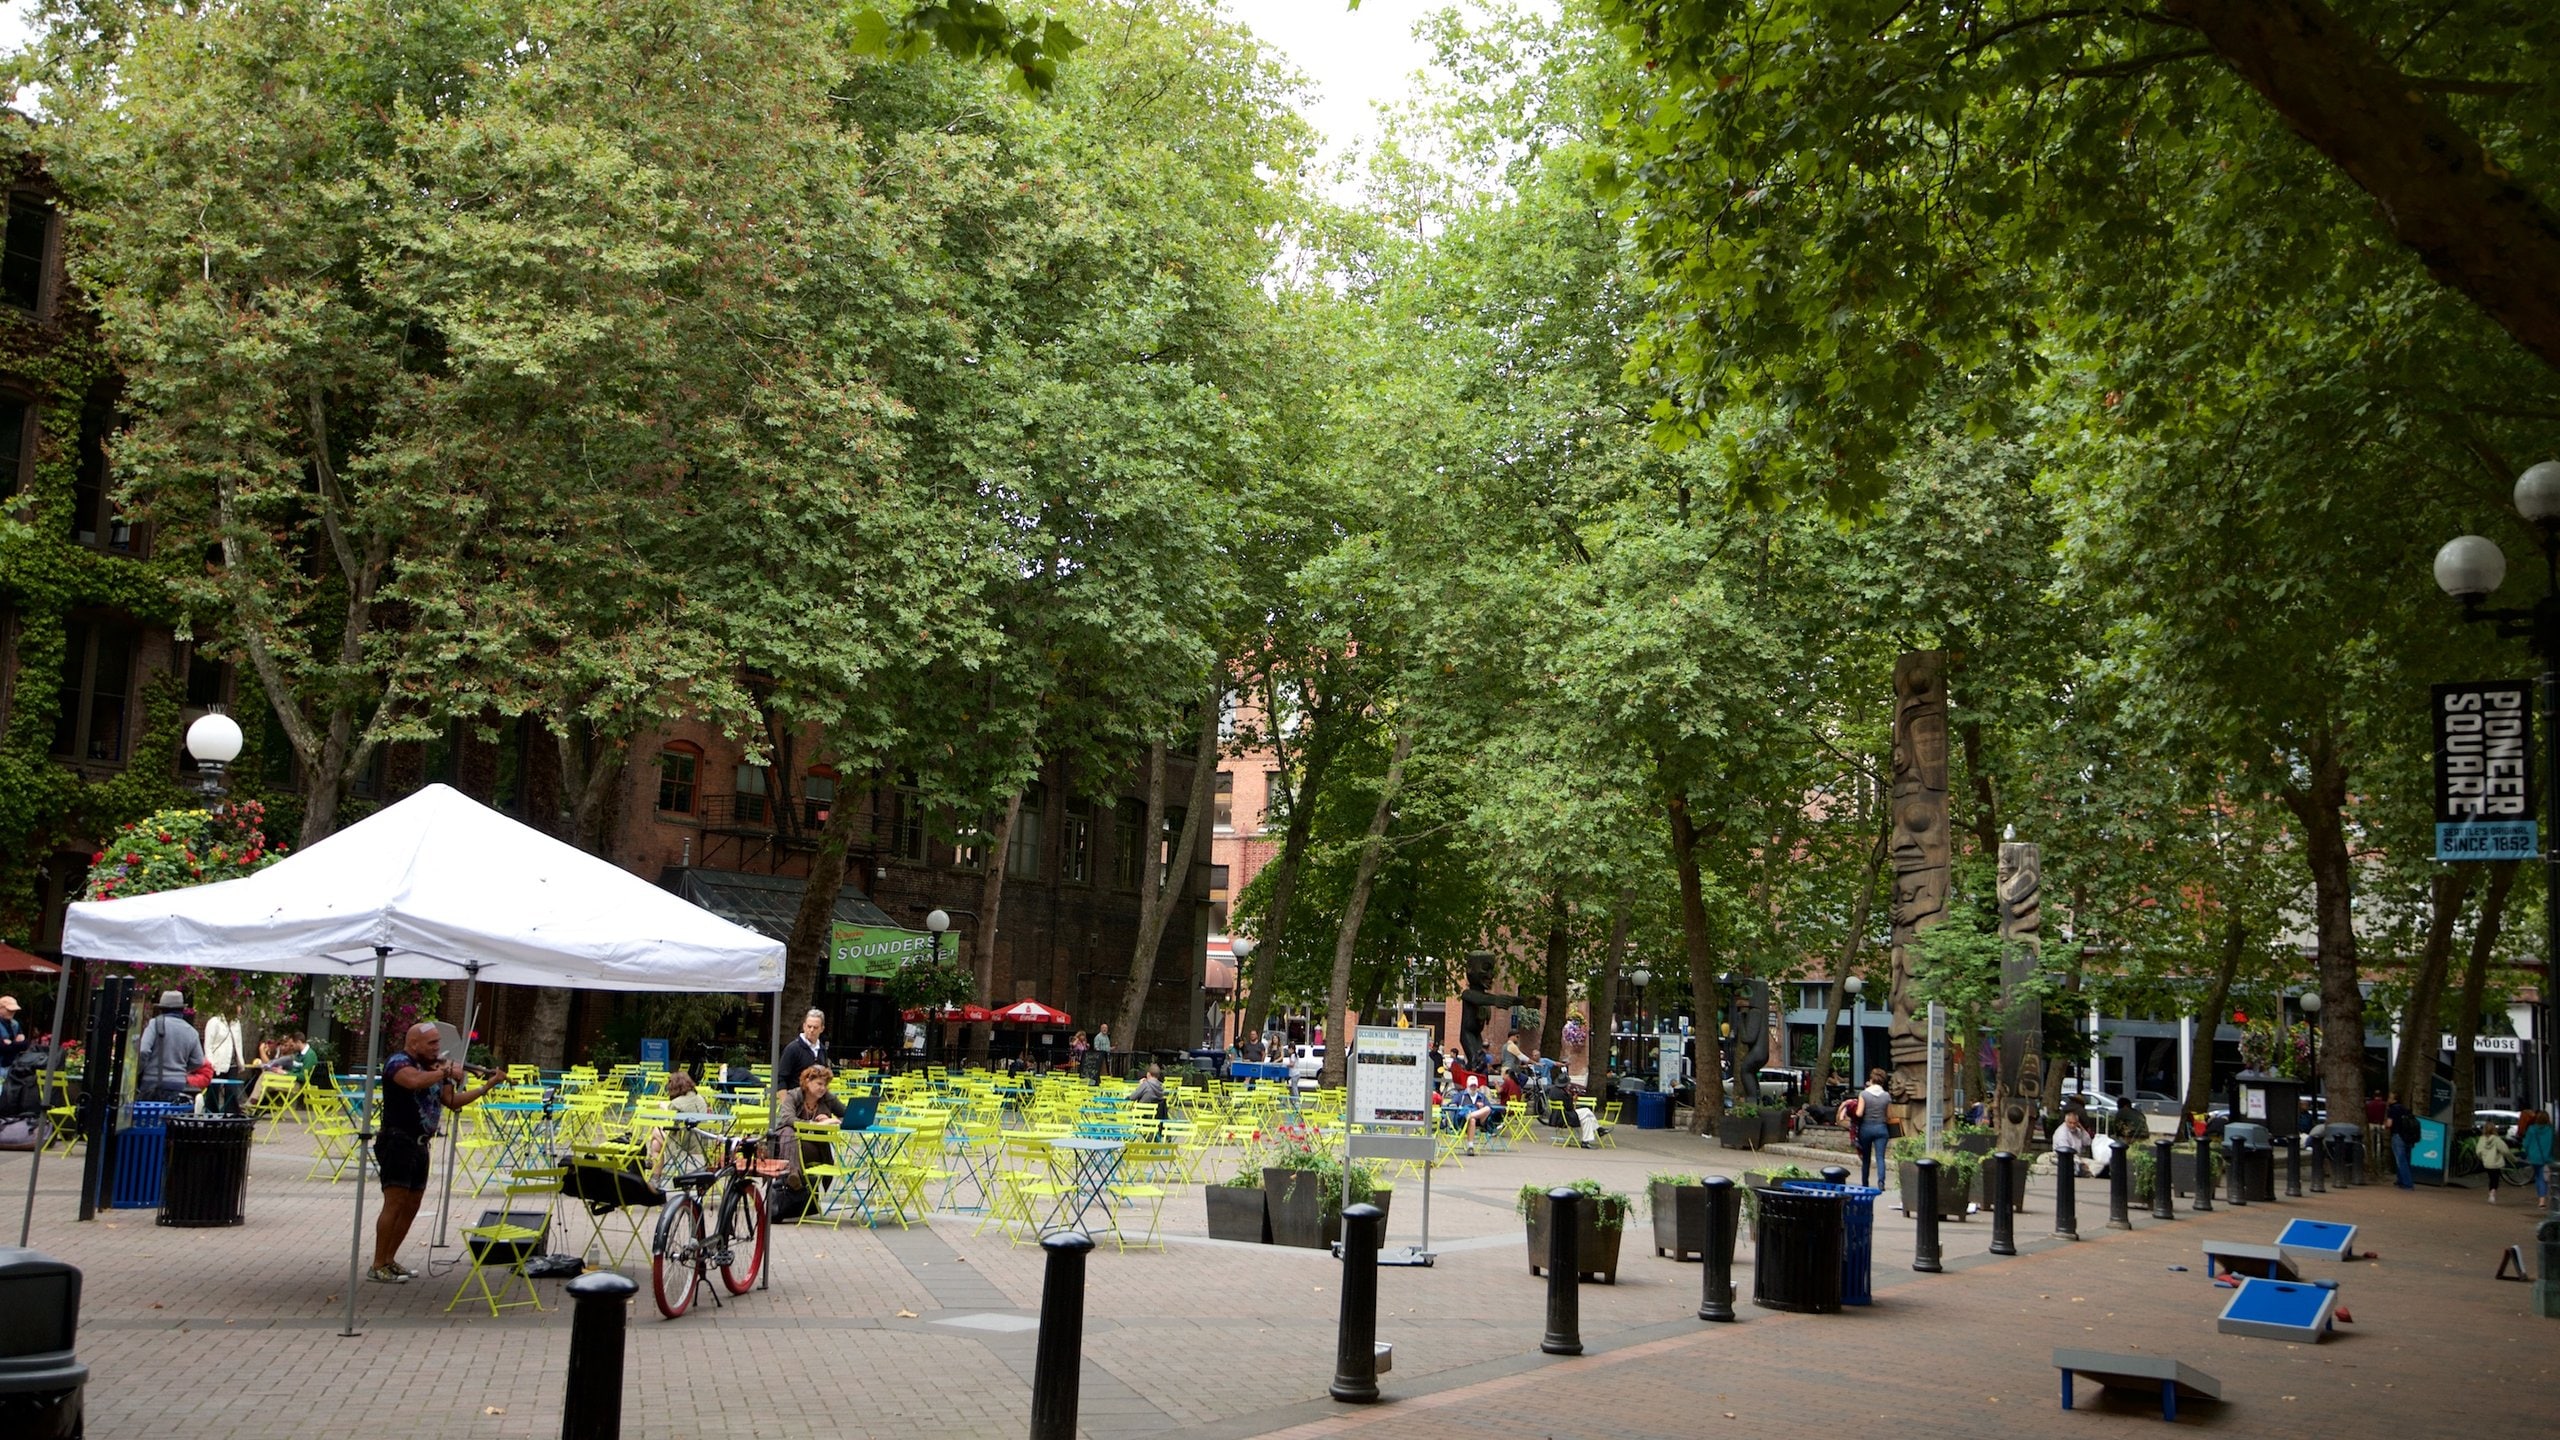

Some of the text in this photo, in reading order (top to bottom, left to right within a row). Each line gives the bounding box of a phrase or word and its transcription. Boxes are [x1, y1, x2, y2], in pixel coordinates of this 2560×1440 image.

[2444, 692, 2486, 816] SQUARE
[2484, 690, 2525, 815] PIONEER
[2490, 827, 2529, 836] ORIGINAL
[2443, 836, 2530, 852] SINCE 1852
[837, 935, 935, 960] SOUNDERS
[1358, 1030, 1399, 1039] OCCIDENTAL PARK
